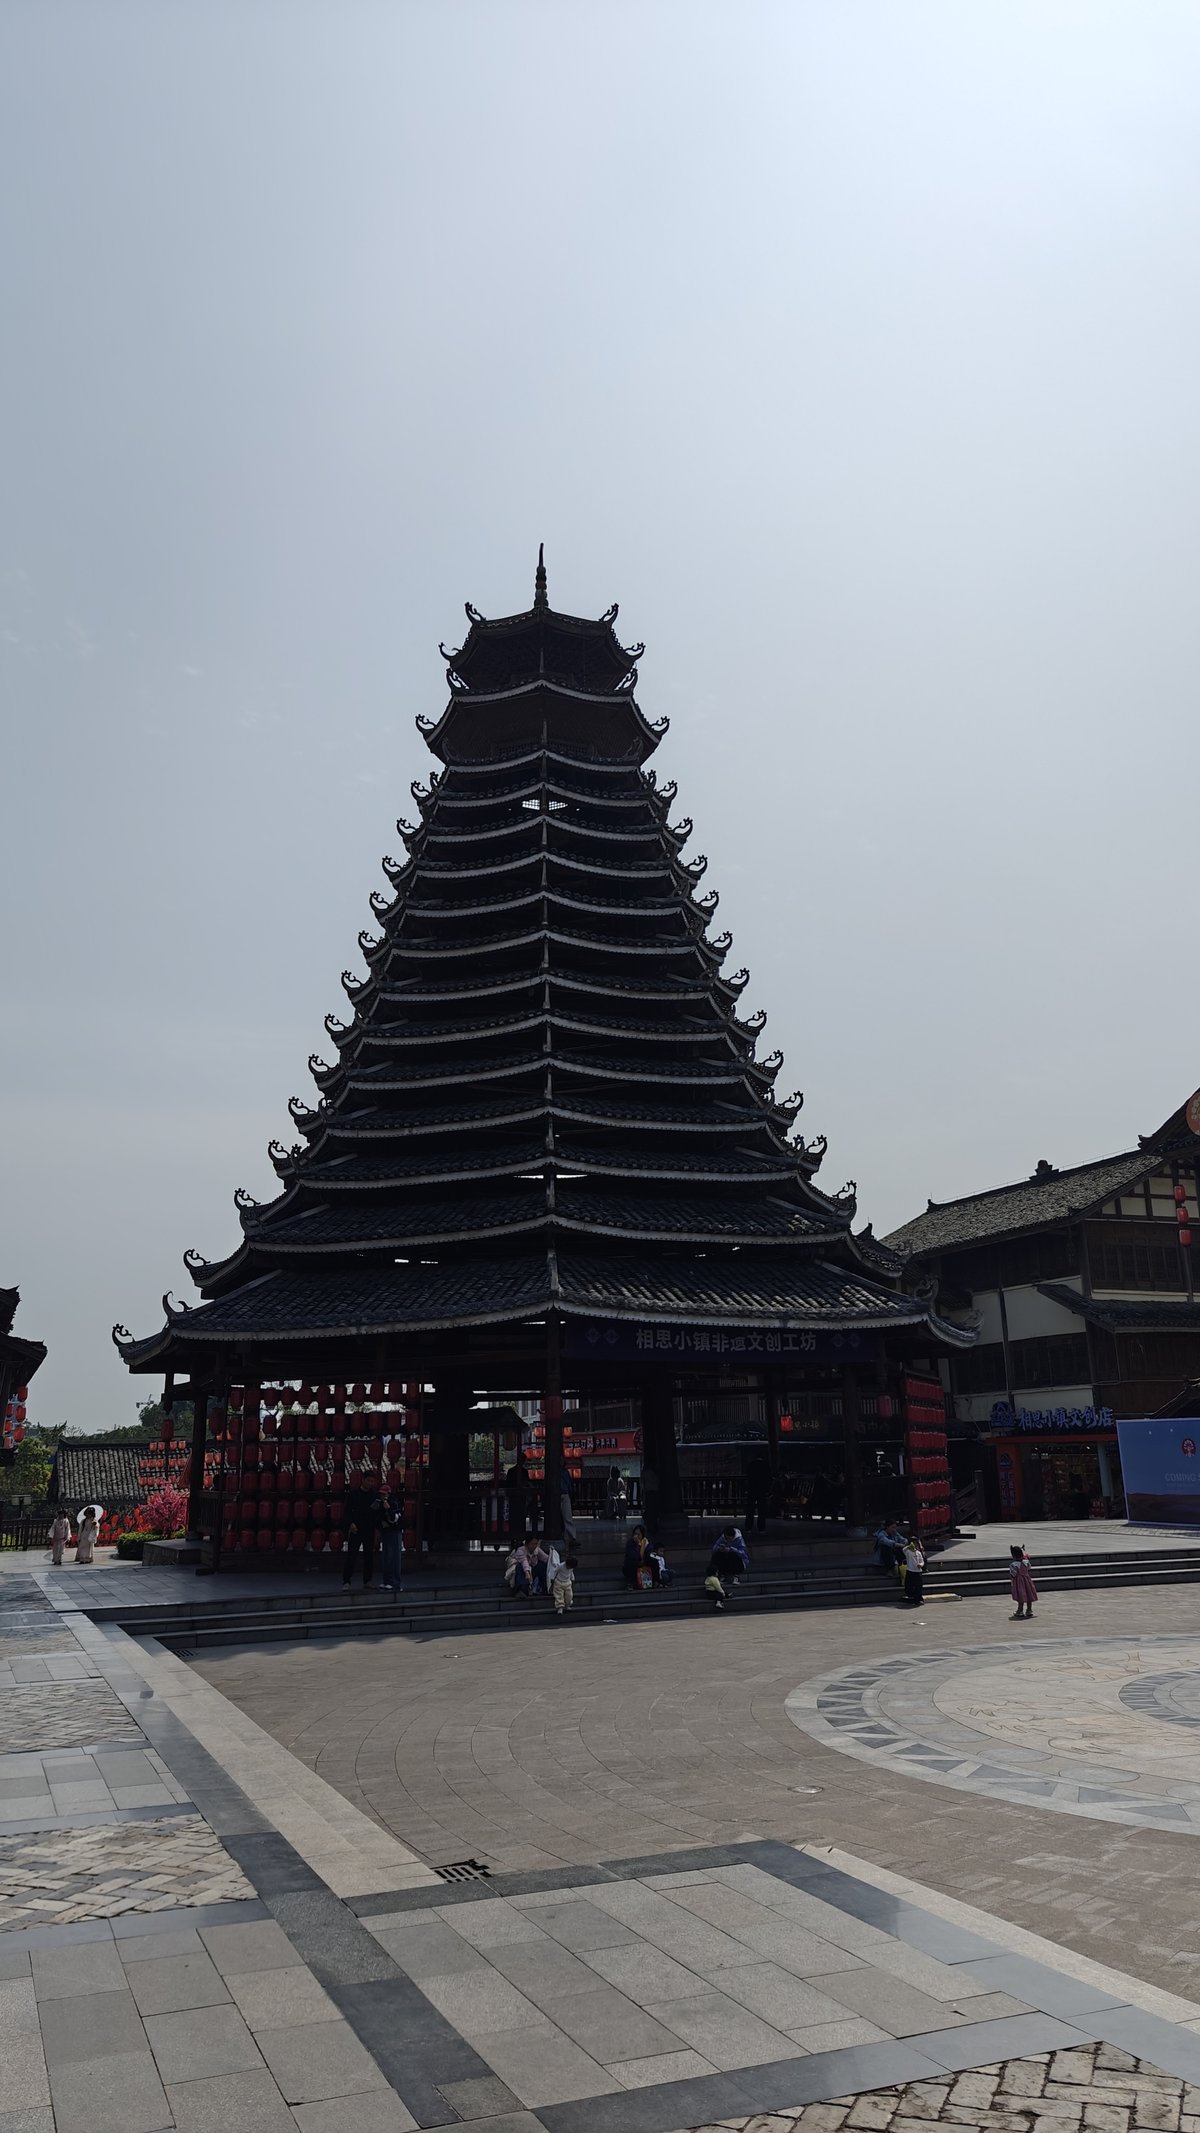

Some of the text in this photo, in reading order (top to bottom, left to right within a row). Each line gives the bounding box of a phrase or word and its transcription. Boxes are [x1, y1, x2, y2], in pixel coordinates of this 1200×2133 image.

[636, 1329, 816, 1352] 相思小镇非遗文创工坊
[1020, 1406, 1113, 1431] 相思小镇文创店
[1164, 1472, 1197, 1482] COMING
